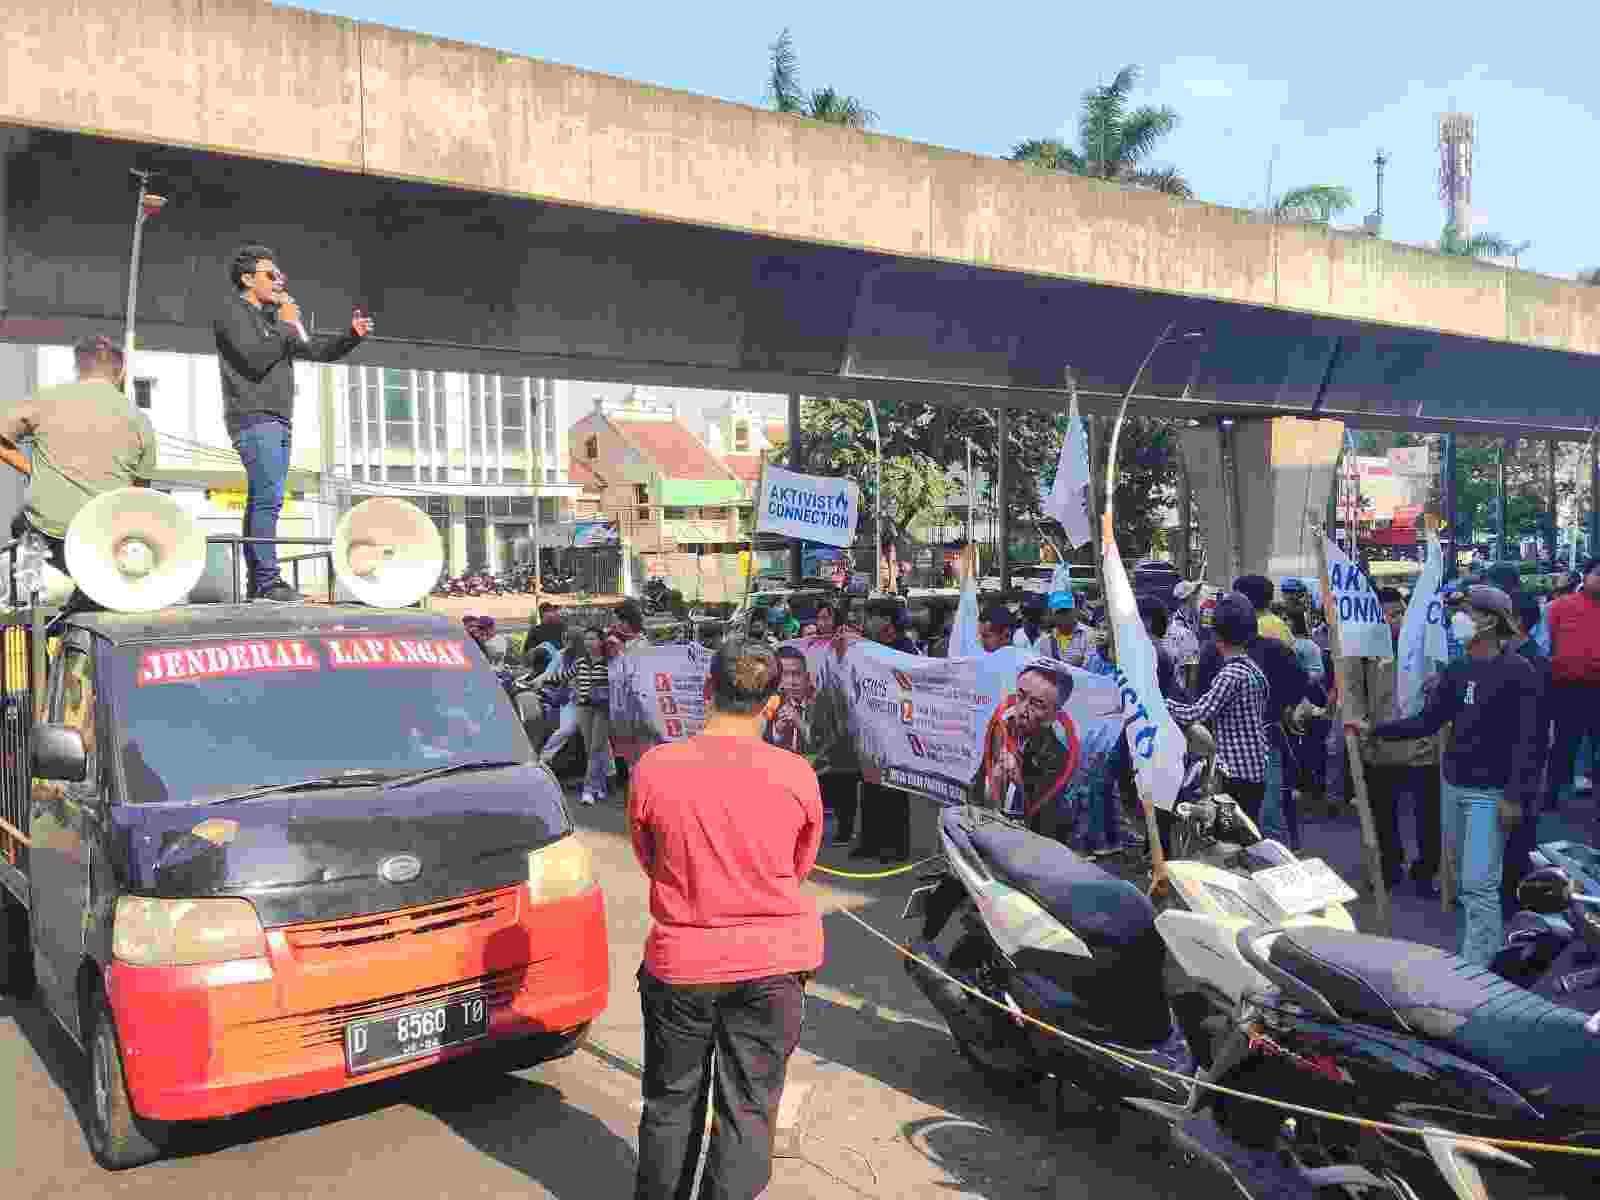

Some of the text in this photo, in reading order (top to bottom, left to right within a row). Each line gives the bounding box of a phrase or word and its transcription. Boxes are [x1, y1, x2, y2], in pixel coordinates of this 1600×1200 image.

[768, 502, 849, 528] CONNECTION
[1334, 594, 1385, 625] ONN
[142, 638, 466, 681] JENDERAL LAPANGAN
[353, 1026, 368, 1053] D
[397, 1007, 447, 1042] 8560
